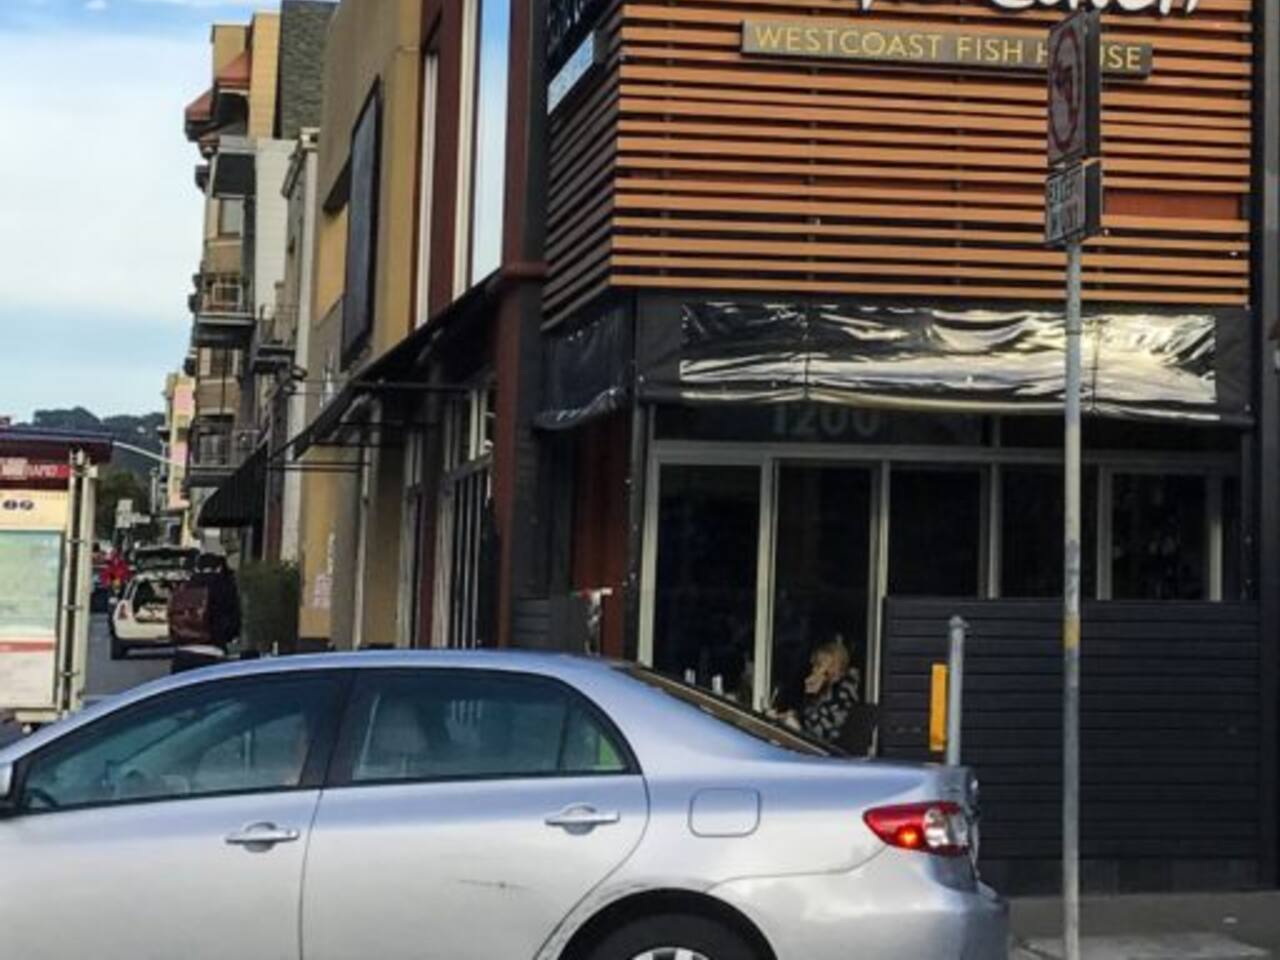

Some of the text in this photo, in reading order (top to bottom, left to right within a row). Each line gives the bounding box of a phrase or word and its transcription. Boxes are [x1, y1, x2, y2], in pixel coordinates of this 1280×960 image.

[753, 24, 1142, 69] WESTCOAST FISH HSE
